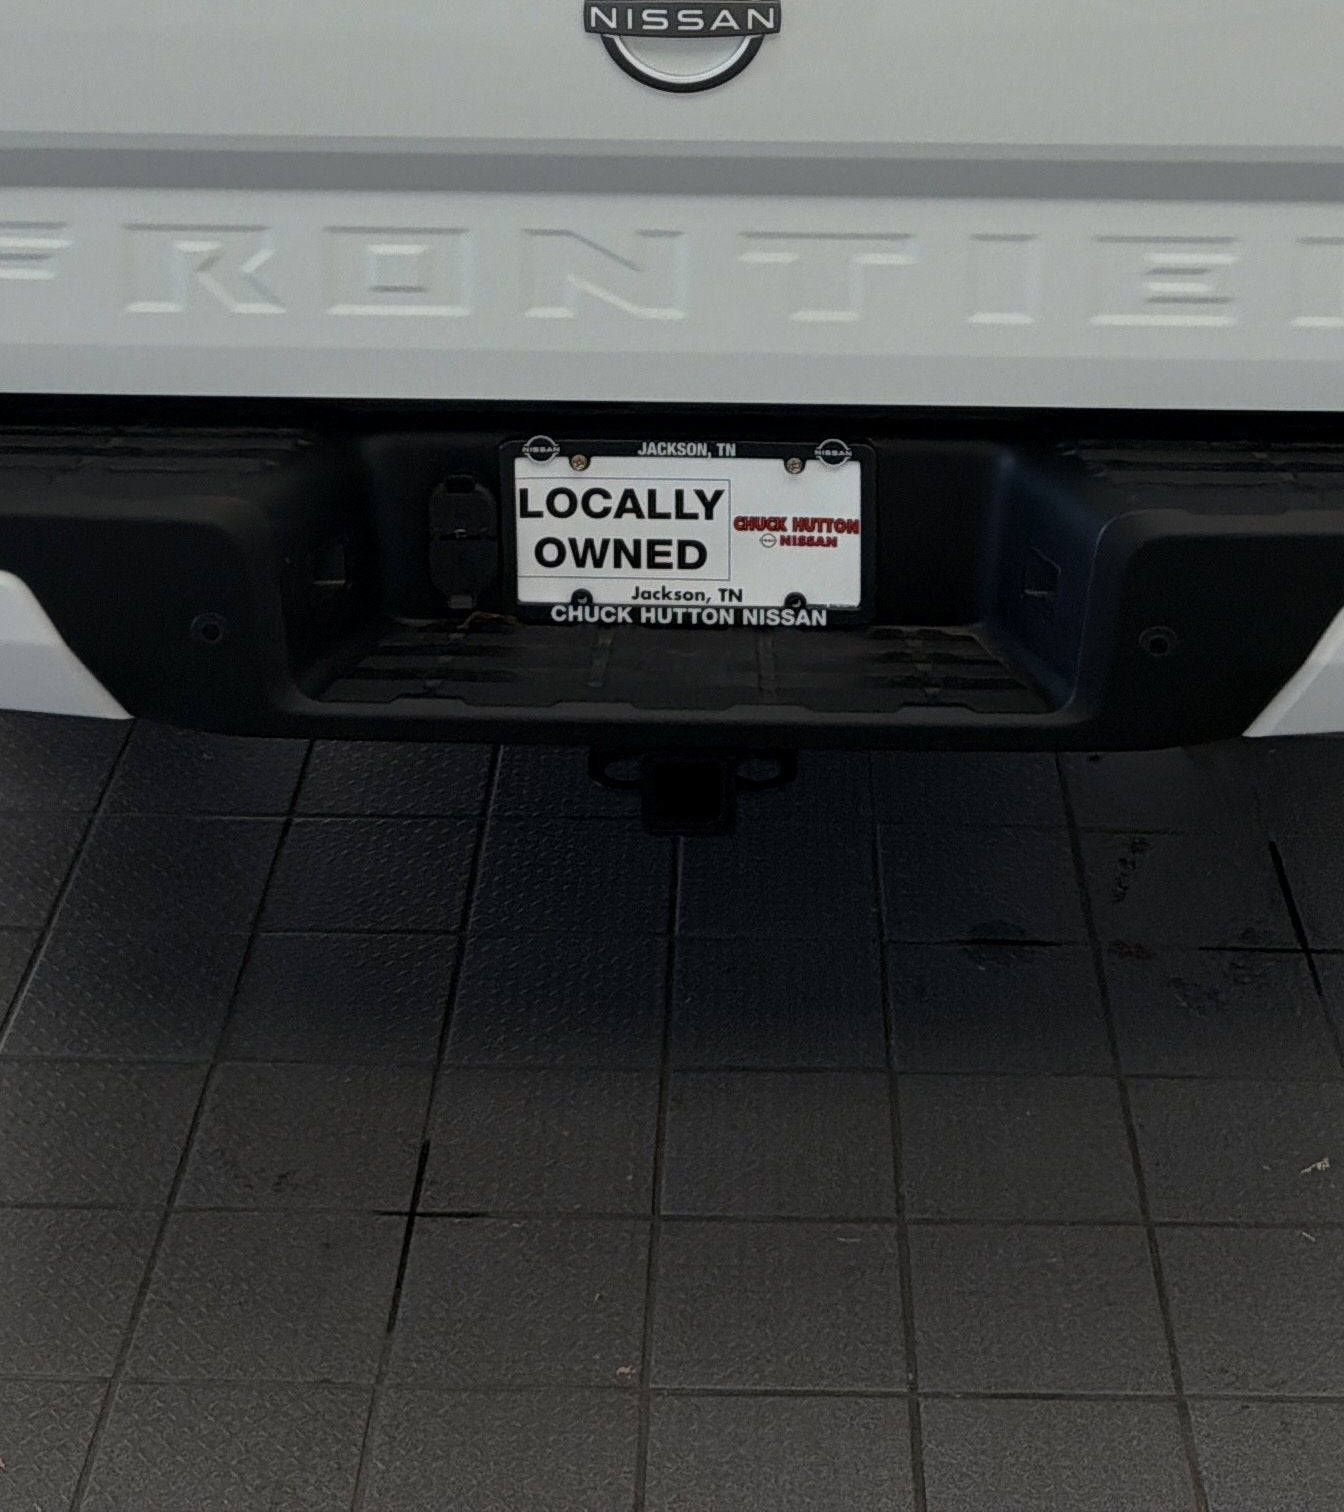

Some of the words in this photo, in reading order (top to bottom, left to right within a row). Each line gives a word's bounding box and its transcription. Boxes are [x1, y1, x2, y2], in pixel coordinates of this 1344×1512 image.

[590, 6, 775, 31] NISSAN
[521, 446, 561, 454] NISSAN
[637, 441, 712, 459] JACKSON,
[716, 442, 737, 457] TN
[814, 449, 853, 457] NISSAN
[519, 486, 725, 521] LOCALLY
[733, 515, 788, 532] CHUCK
[792, 516, 860, 535] HUTTON
[779, 534, 838, 548] NISSAN
[534, 536, 708, 570] OWNED
[631, 585, 712, 604] Jackson,
[718, 587, 743, 603] TN
[550, 605, 633, 624] CHUCK
[640, 606, 735, 626] HUTTON
[742, 608, 828, 627] NISSAN
